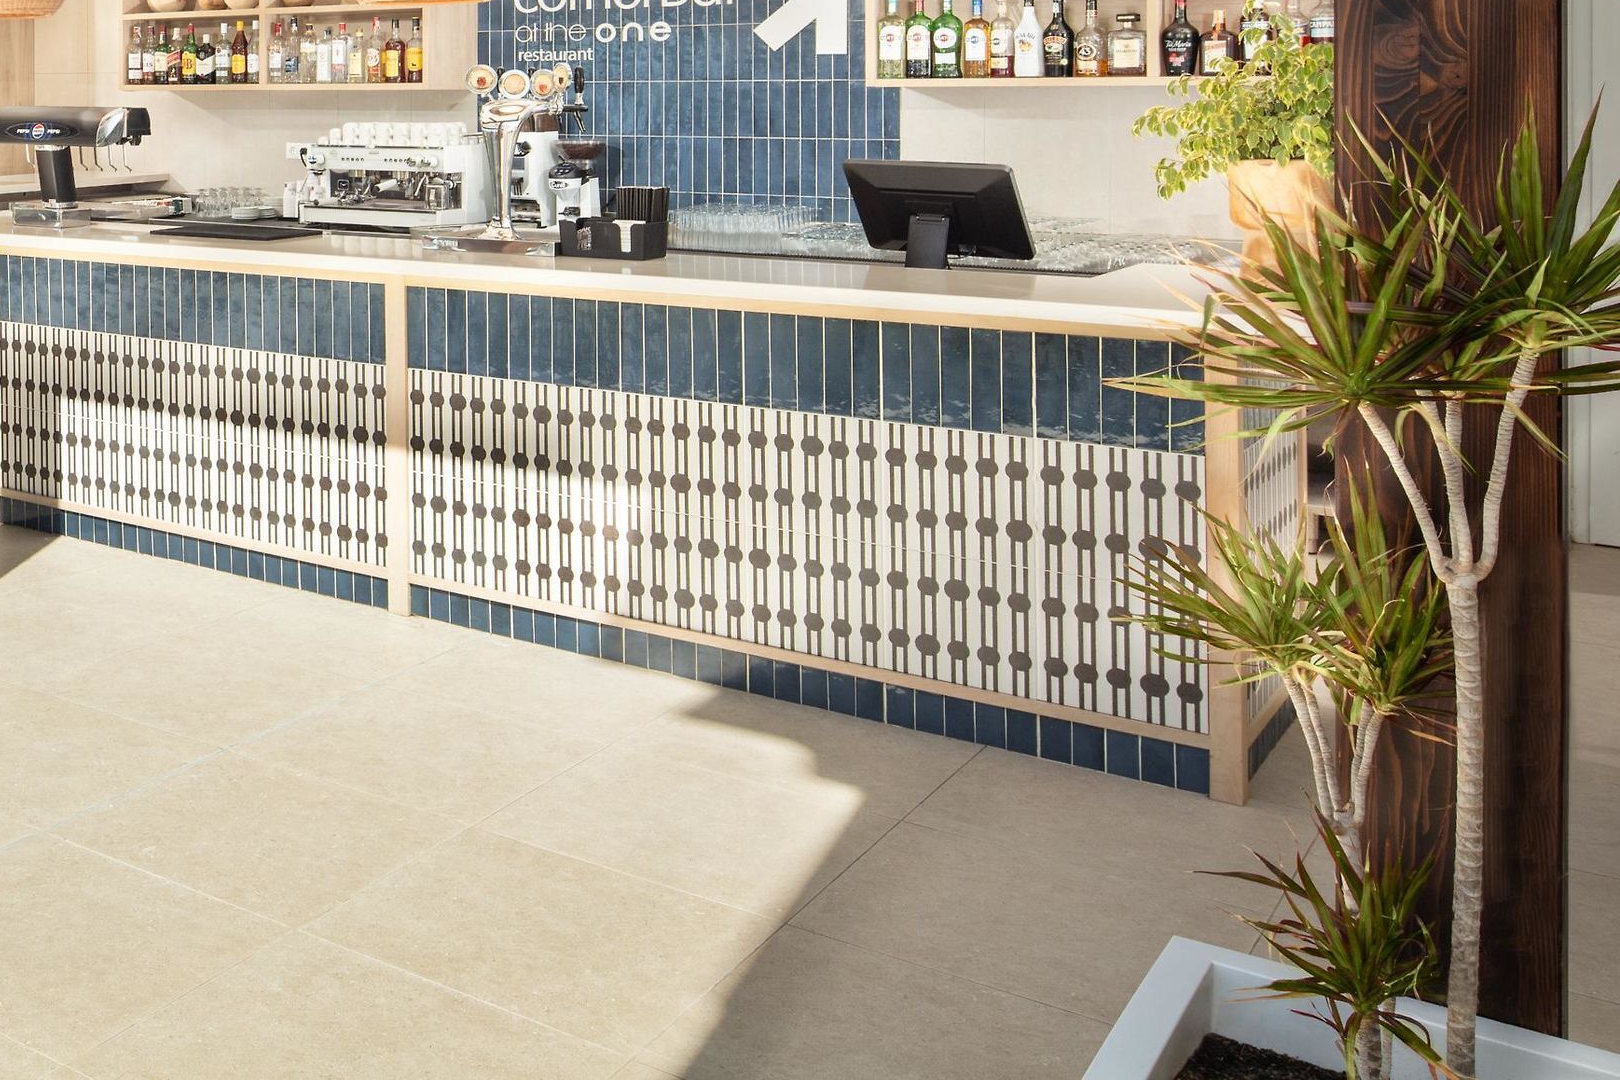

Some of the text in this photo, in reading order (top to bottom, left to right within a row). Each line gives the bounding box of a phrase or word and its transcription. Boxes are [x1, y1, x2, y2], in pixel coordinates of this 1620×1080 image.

[515, 21, 672, 43] at the one
[518, 47, 594, 62] restaurant
